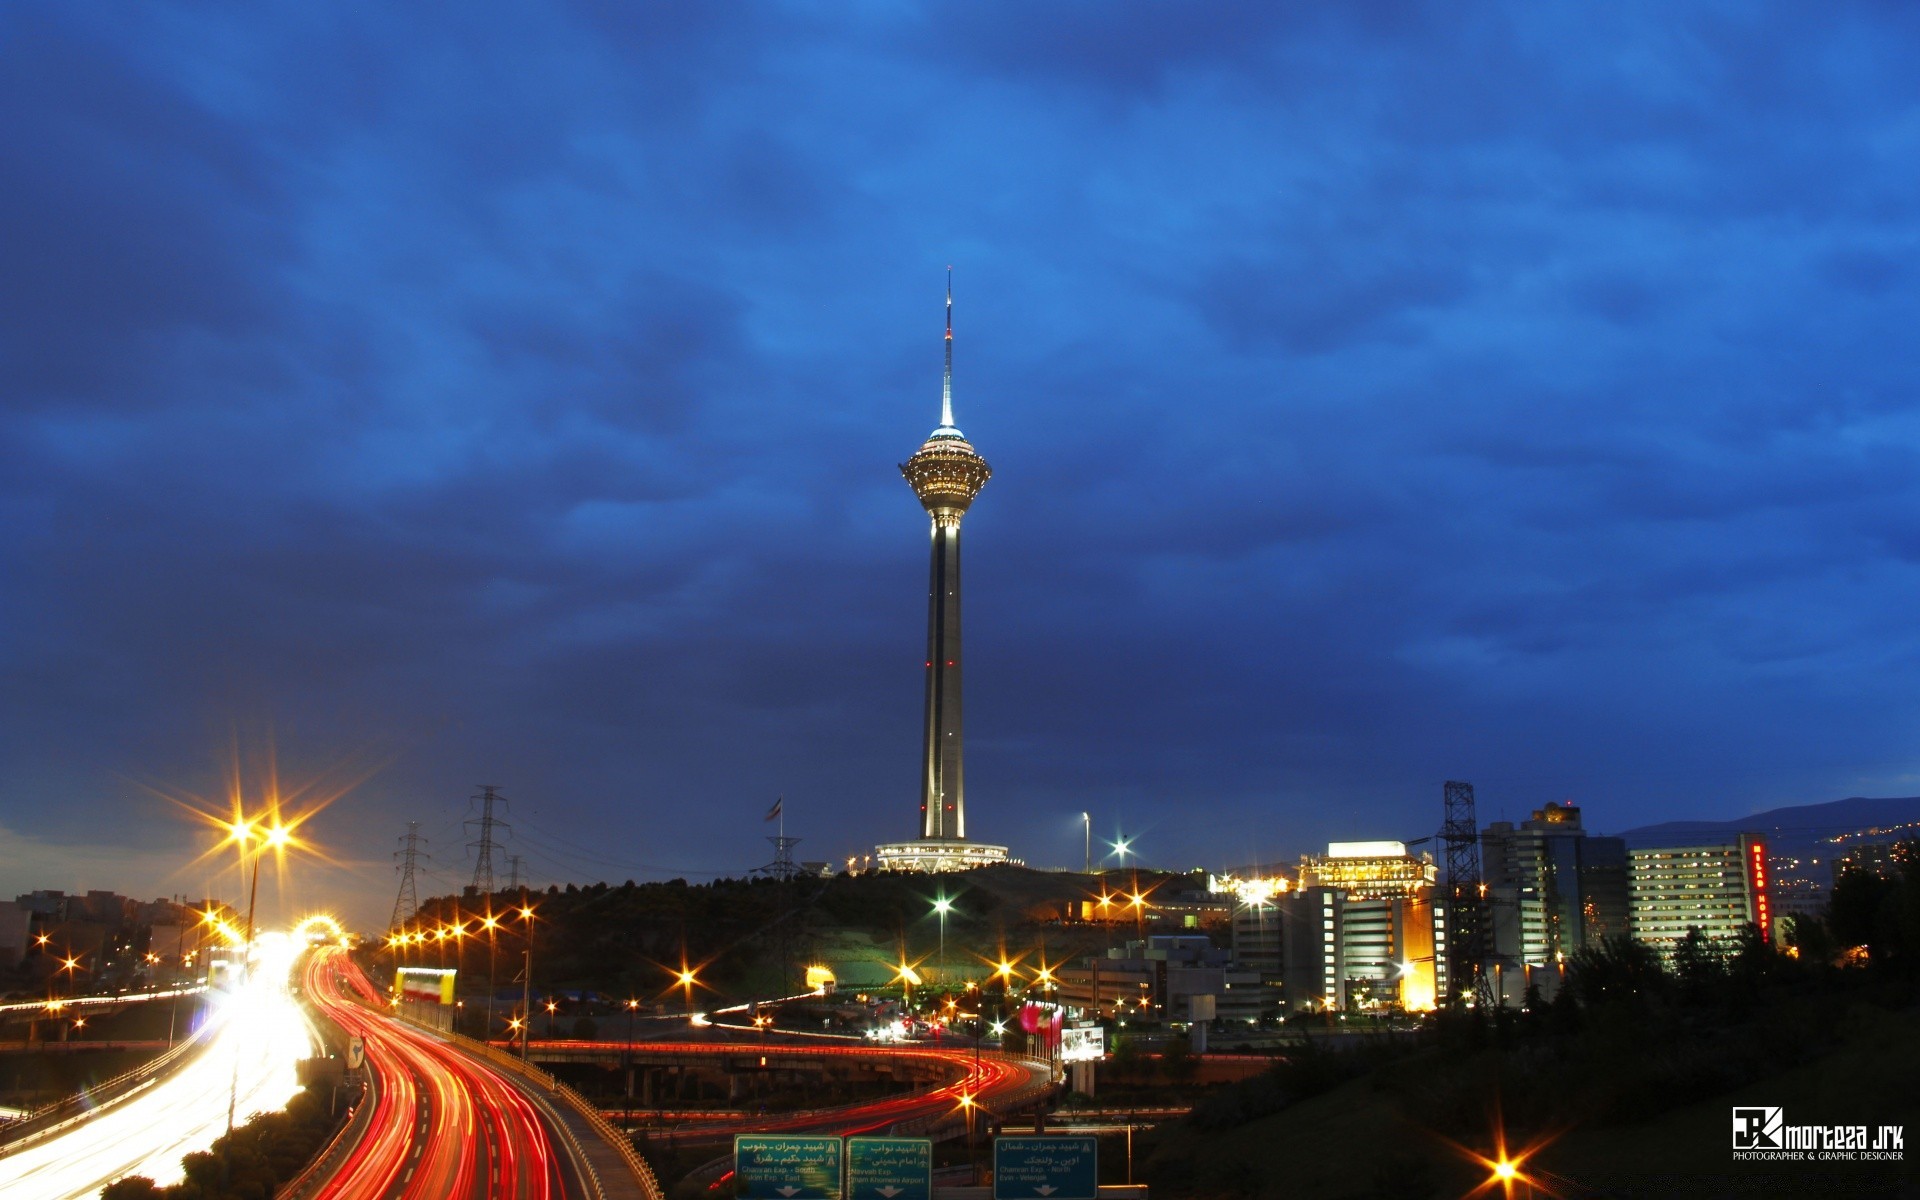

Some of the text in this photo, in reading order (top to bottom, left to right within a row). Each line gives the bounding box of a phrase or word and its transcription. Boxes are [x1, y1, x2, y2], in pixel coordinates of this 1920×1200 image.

[1753, 845, 1764, 888] MILAD
[775, 1142, 801, 1153] چمران
[803, 1142, 825, 1152] شهید
[1001, 1142, 1024, 1153] شمال
[1031, 1142, 1057, 1153] چمران
[1058, 1142, 1080, 1152] شهید
[753, 1153, 774, 1164] شرق
[780, 1154, 801, 1165] حکیم
[803, 1154, 825, 1164] شهید
[898, 1156, 917, 1167] امام
[1060, 1156, 1080, 1166] اوین
[901, 1176, 924, 1184] Airport
[999, 1174, 1014, 1182] Evin
